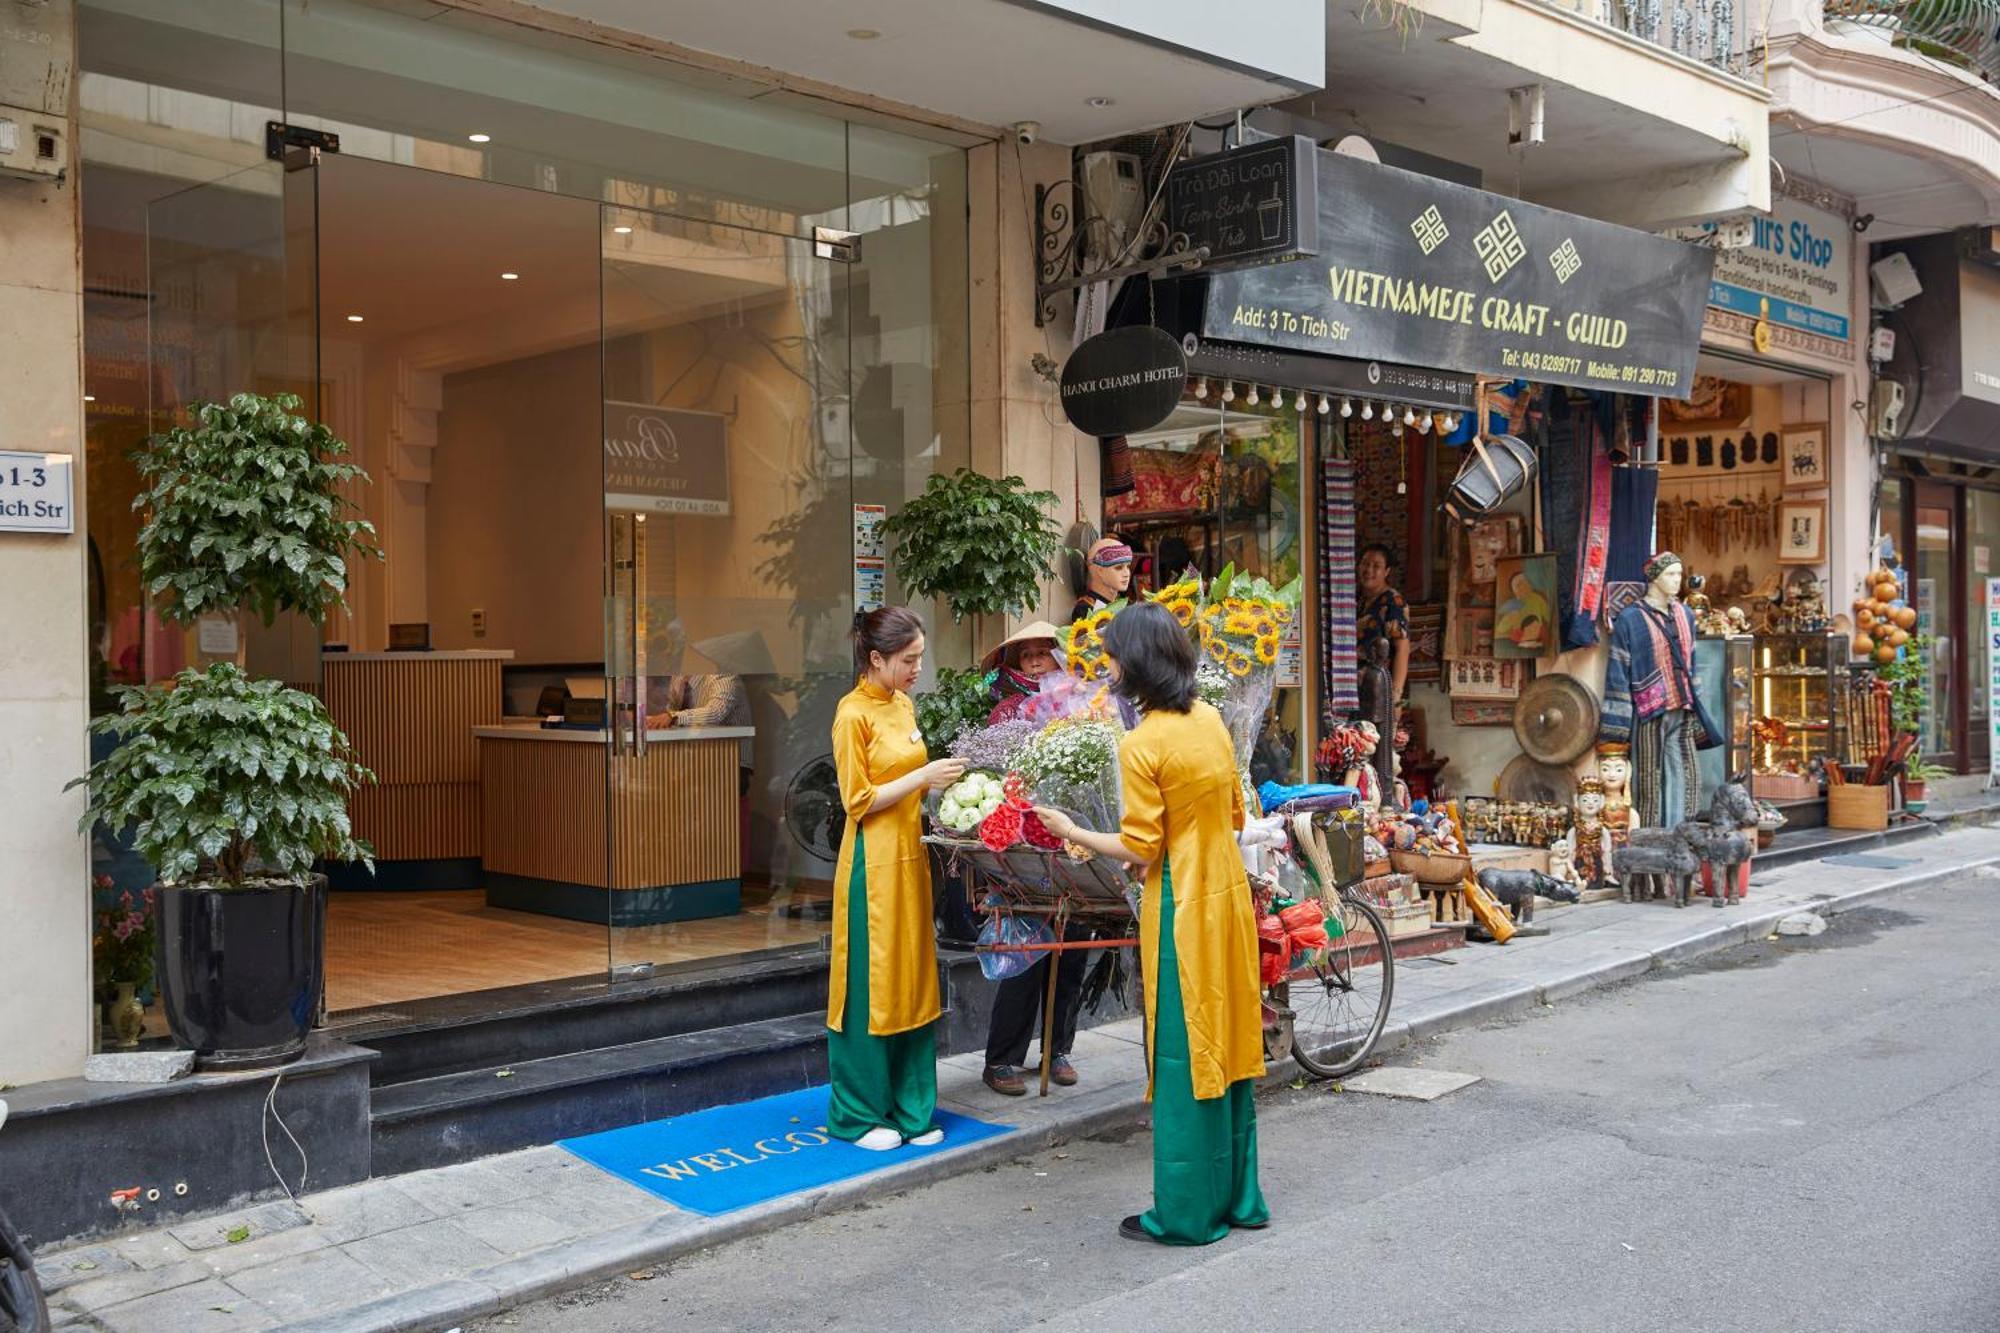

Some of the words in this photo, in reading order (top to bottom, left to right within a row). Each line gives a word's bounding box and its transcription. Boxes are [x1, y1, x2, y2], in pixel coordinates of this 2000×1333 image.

[1238, 161, 1284, 183] Loan
[1790, 220, 1833, 269] Shop
[1232, 304, 1266, 328] Add:
[1269, 309, 1279, 330] 3
[1282, 311, 1298, 333] To
[1301, 314, 1328, 338] Tich
[1330, 320, 1351, 341] Str
[1330, 265, 1476, 325] VIETNAMESE
[1481, 296, 1550, 337] CRAFT
[1566, 312, 1629, 350] GUILD
[1063, 380, 1096, 397] HANOI
[1099, 373, 1141, 391] CHARM
[1144, 366, 1184, 383] HOTEL
[1502, 348, 1520, 367] Tel:
[1521, 351, 1540, 370] 043
[1586, 360, 1620, 380] Mobile:
[1656, 369, 1678, 388] 7713
[10, 467, 47, 488] 1-3
[0, 500, 30, 517] ich
[34, 500, 64, 518] Str
[640, 1126, 829, 1183] WELCO
